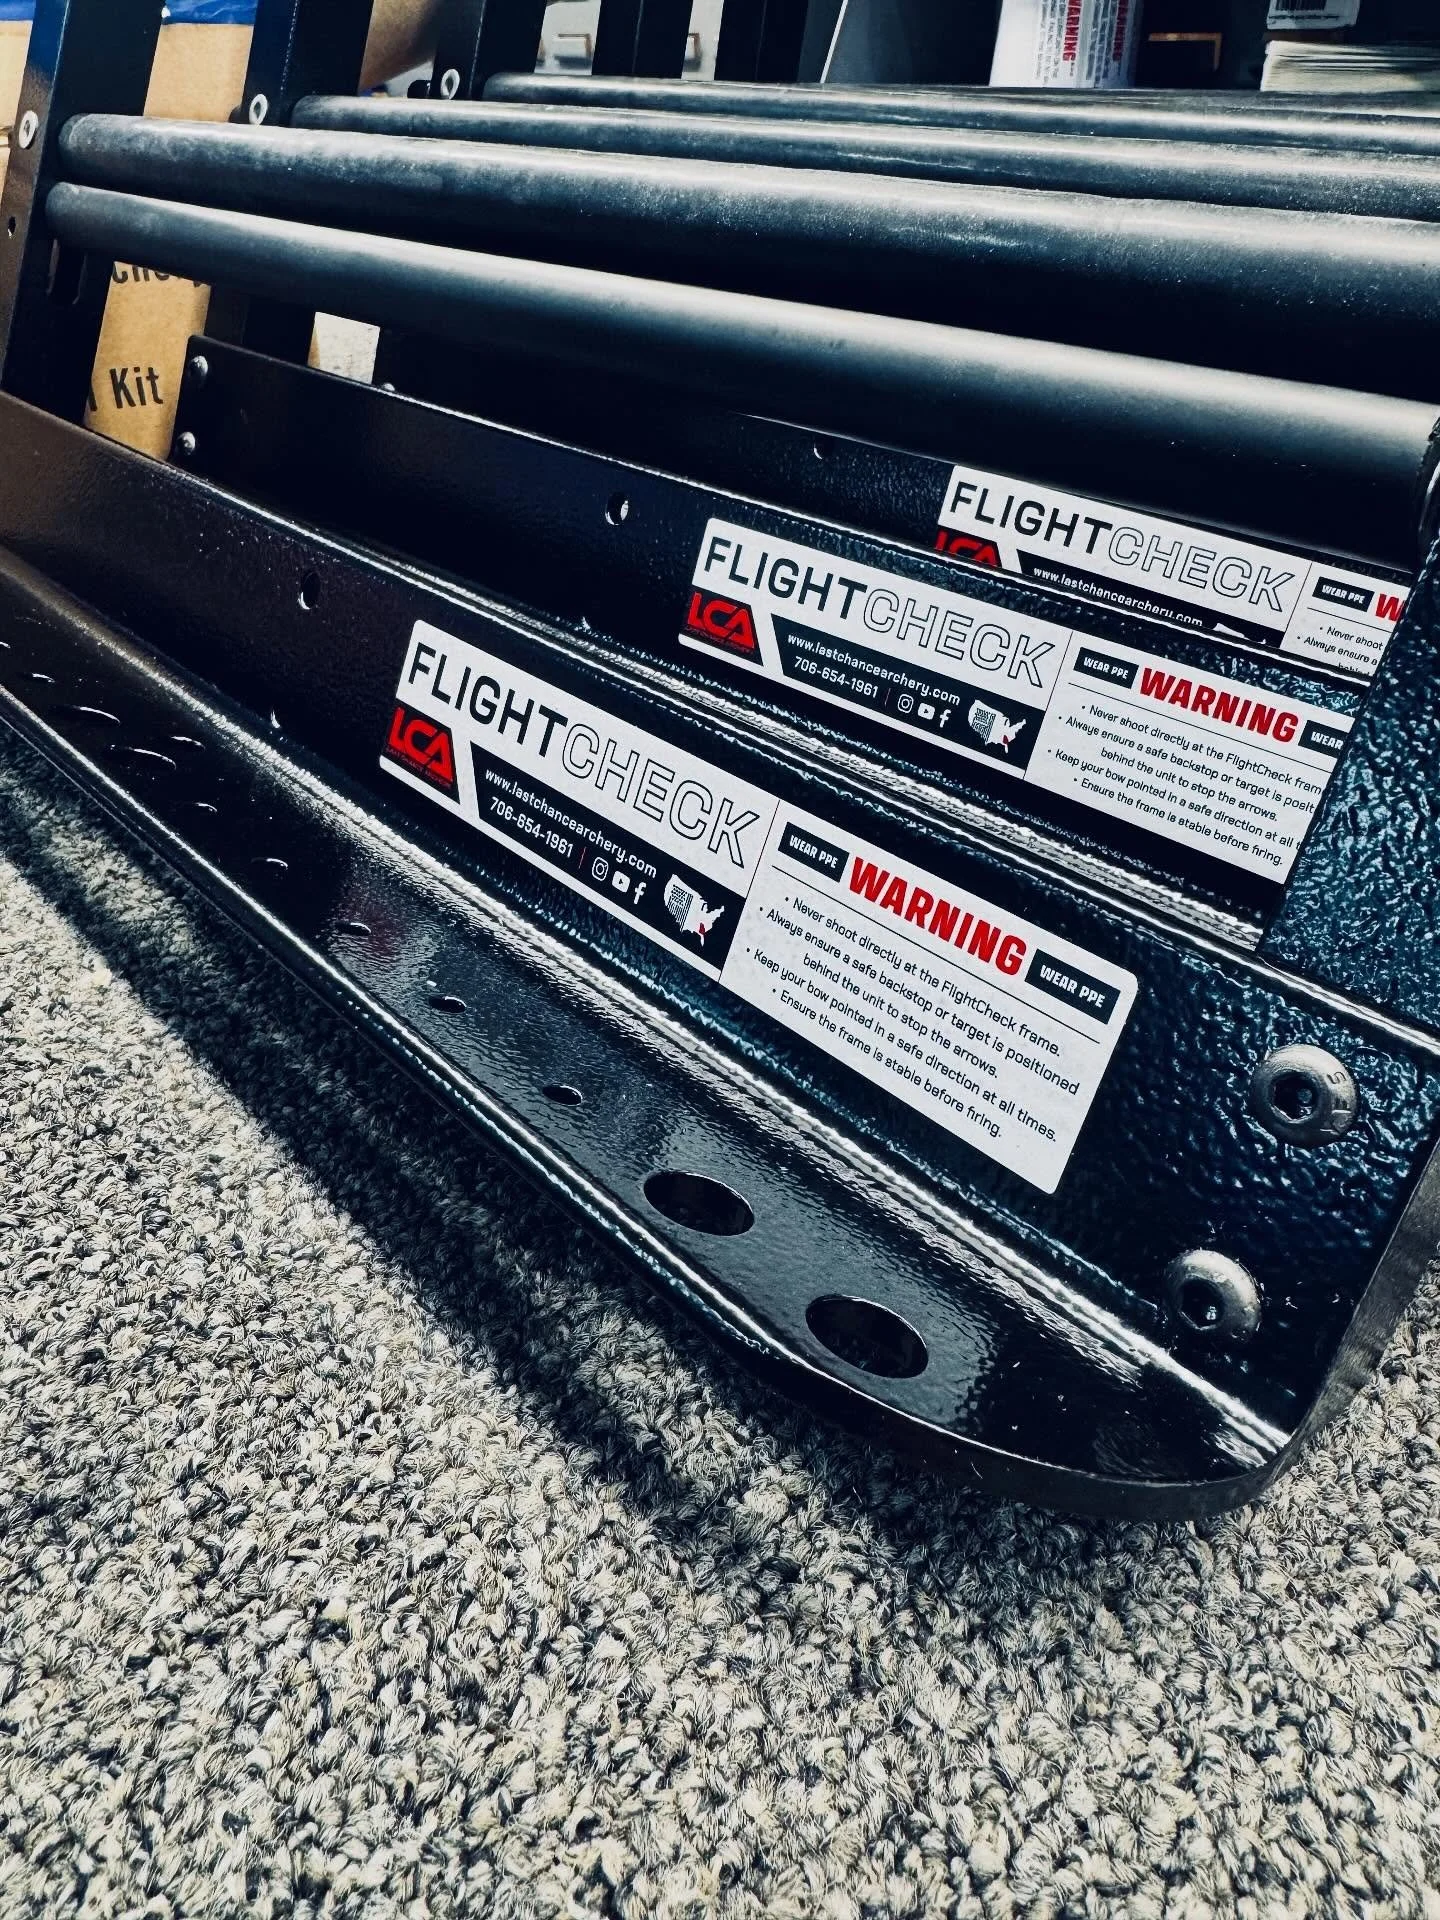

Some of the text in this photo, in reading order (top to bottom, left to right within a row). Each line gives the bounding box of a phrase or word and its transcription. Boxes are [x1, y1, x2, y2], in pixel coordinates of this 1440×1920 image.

[109, 366, 164, 409] Kit
[949, 480, 1295, 612] FLIGHTCHECK
[687, 592, 754, 648] LCA
[703, 536, 1055, 688] FLIGHTCHECK
[1321, 584, 1365, 603] WEAR PPE
[787, 634, 960, 705] www.lastchancearchery.com
[1083, 656, 1128, 679] WEAR PPE
[1303, 636, 1336, 653] Always
[1337, 647, 1369, 662] ensure
[1326, 626, 1383, 650] Never shoot
[794, 655, 878, 697] 706-654-1961
[1140, 668, 1297, 742] WARNING
[388, 707, 452, 781] LCA
[407, 641, 760, 869] FLIGHTCHECK
[1065, 715, 1099, 735] Always
[1100, 730, 1135, 750] ensure
[1136, 743, 1143, 751] a
[1144, 746, 1168, 759] safe
[1169, 752, 1218, 779] backstop
[1220, 773, 1233, 783] or
[1235, 776, 1270, 797] target
[1271, 789, 1282, 801] is
[1089, 704, 1321, 794] Never shoot directly at the FlightCheck fram
[1310, 731, 1343, 749] WEAR
[1055, 748, 1079, 767] Keep
[1080, 760, 1104, 774] your
[1105, 767, 1126, 783] bow
[1125, 778, 1166, 799] pointed
[1167, 791, 1177, 803] in
[1178, 798, 1186, 806] a
[1187, 801, 1212, 816] safe
[1213, 810, 1262, 836] direction
[1264, 831, 1277, 841] at
[1278, 836, 1293, 847] all
[1100, 746, 1277, 821] behind the unit to stop the arrows.
[485, 769, 656, 878] www.lastchancearchery.com
[490, 796, 573, 857] 706-654-1961
[789, 834, 838, 868] WEAR PPE
[1080, 777, 1114, 798] Ensure
[1117, 791, 1133, 805] the
[1135, 799, 1165, 818] frame
[1166, 811, 1176, 822] is
[1177, 817, 1211, 836] stable
[1213, 828, 1249, 851] before
[1251, 844, 1282, 866] firing.
[849, 857, 1026, 975] WARNING
[766, 908, 1080, 1095] Always ensure a safe backstop or target is positioned
[792, 897, 1059, 1056] Never shoot directly at the FlightCheck frame.
[1039, 964, 1105, 1008] WEAR PPE
[753, 948, 1055, 1142] Keep your bow pointed in a safe direction at all times.
[803, 952, 997, 1078] behind the unit to stop the arrows.
[780, 989, 1000, 1137] Ensure the frame is stable before firing.
